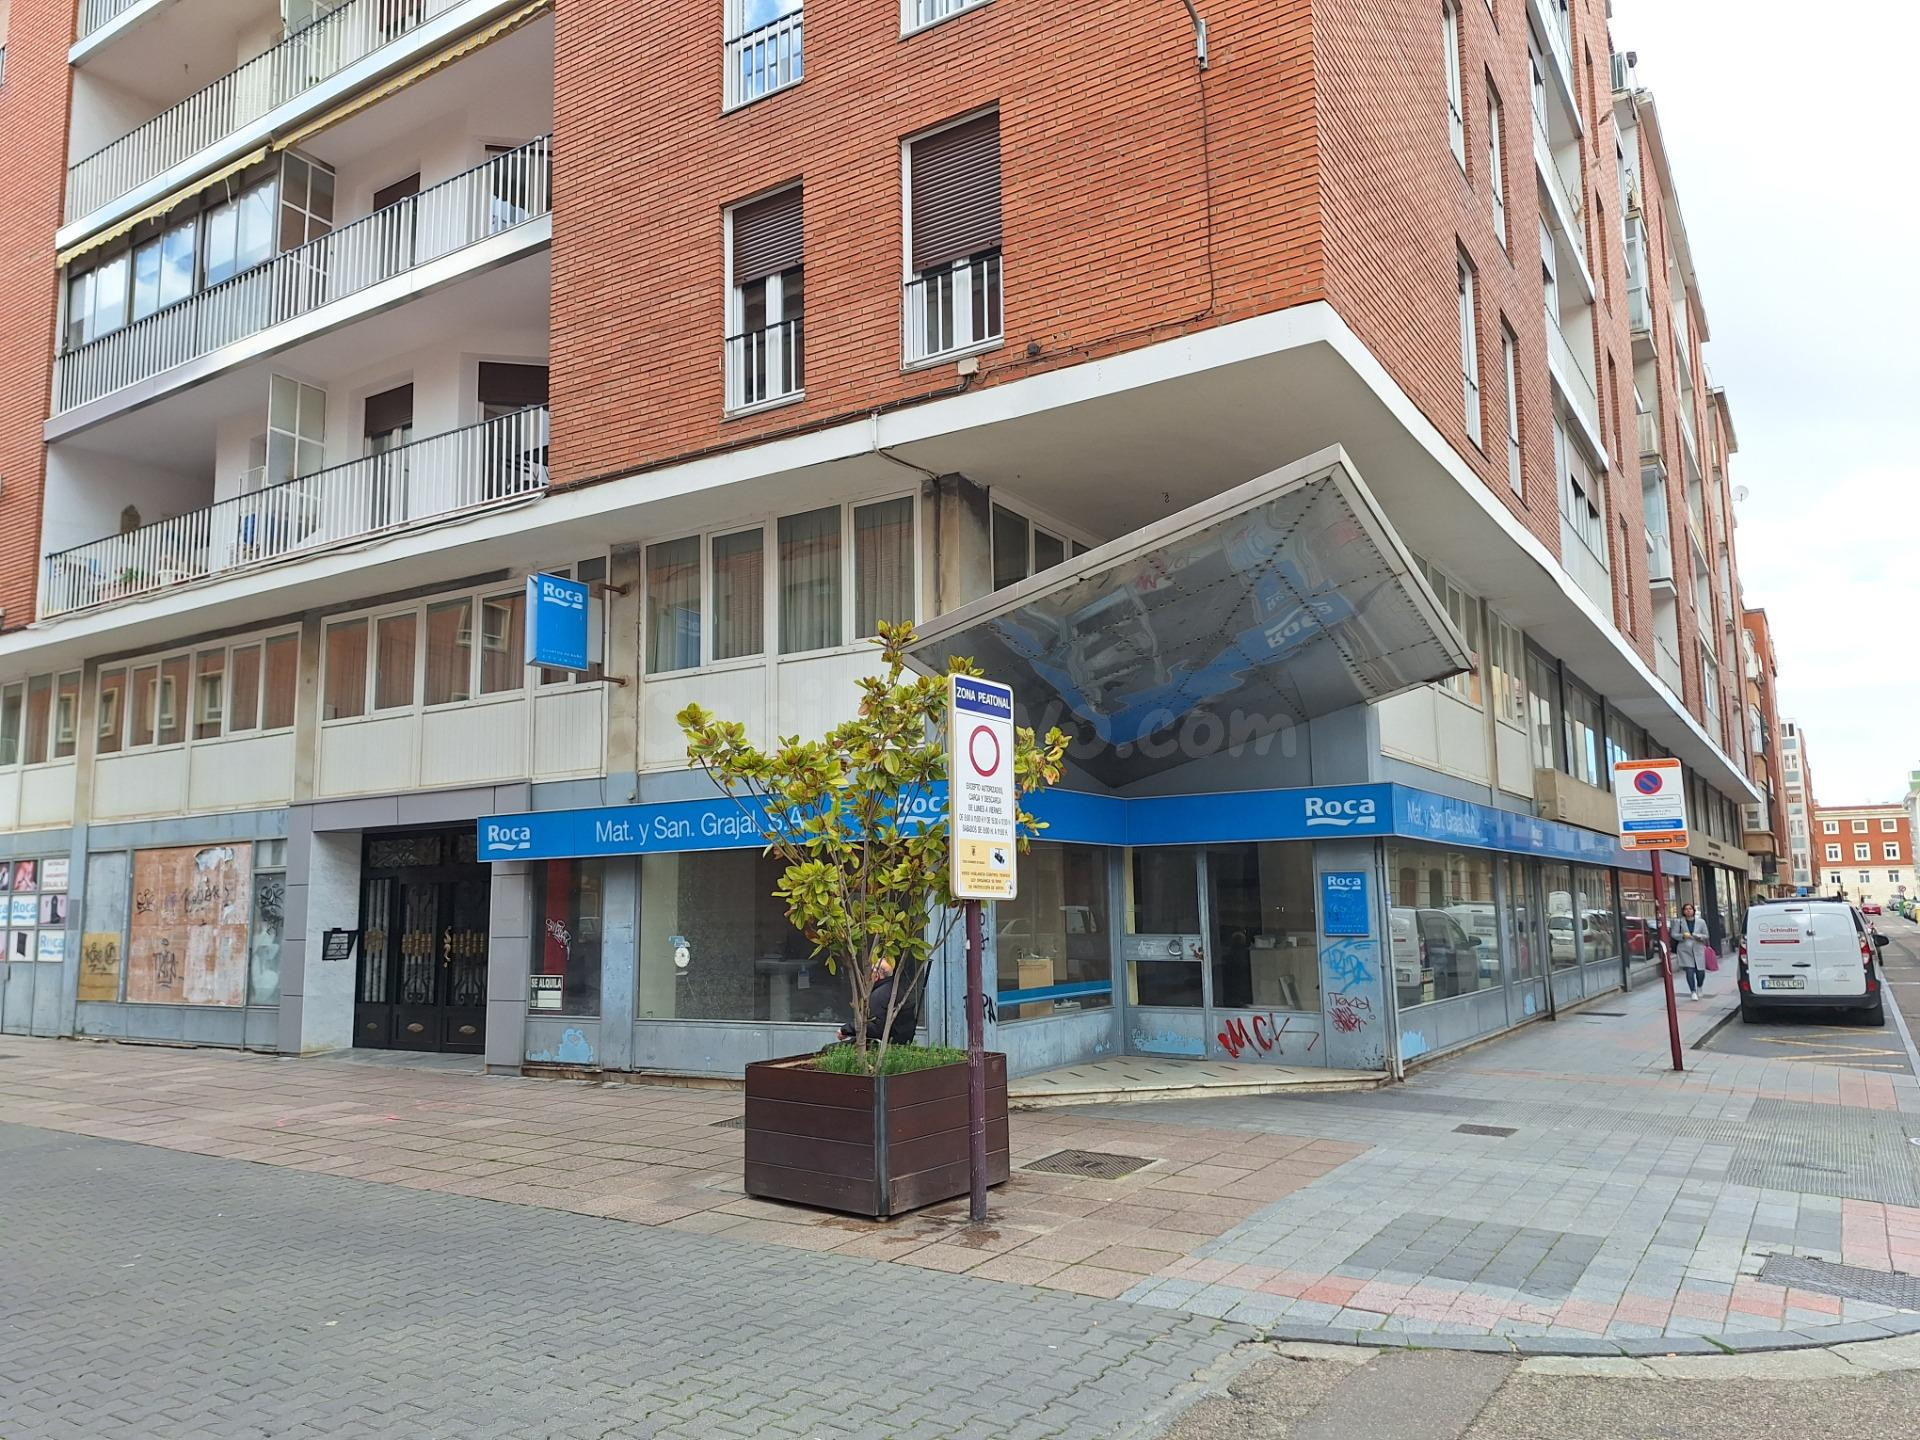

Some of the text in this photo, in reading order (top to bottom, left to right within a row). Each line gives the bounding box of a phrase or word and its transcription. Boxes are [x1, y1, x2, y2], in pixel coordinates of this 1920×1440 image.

[543, 581, 583, 603] Roca
[956, 686, 1011, 709] ZONA PEATONAL
[1305, 797, 1376, 817] Roca
[487, 825, 531, 841] Roca
[595, 820, 634, 843] Mat.
[638, 823, 649, 846] y
[654, 815, 695, 840] San.
[897, 794, 949, 814] Roc
[1327, 875, 1361, 886] Roca
[13, 901, 37, 913] Roca
[40, 936, 64, 949] Roca
[531, 978, 562, 989] SE ALQUILA
